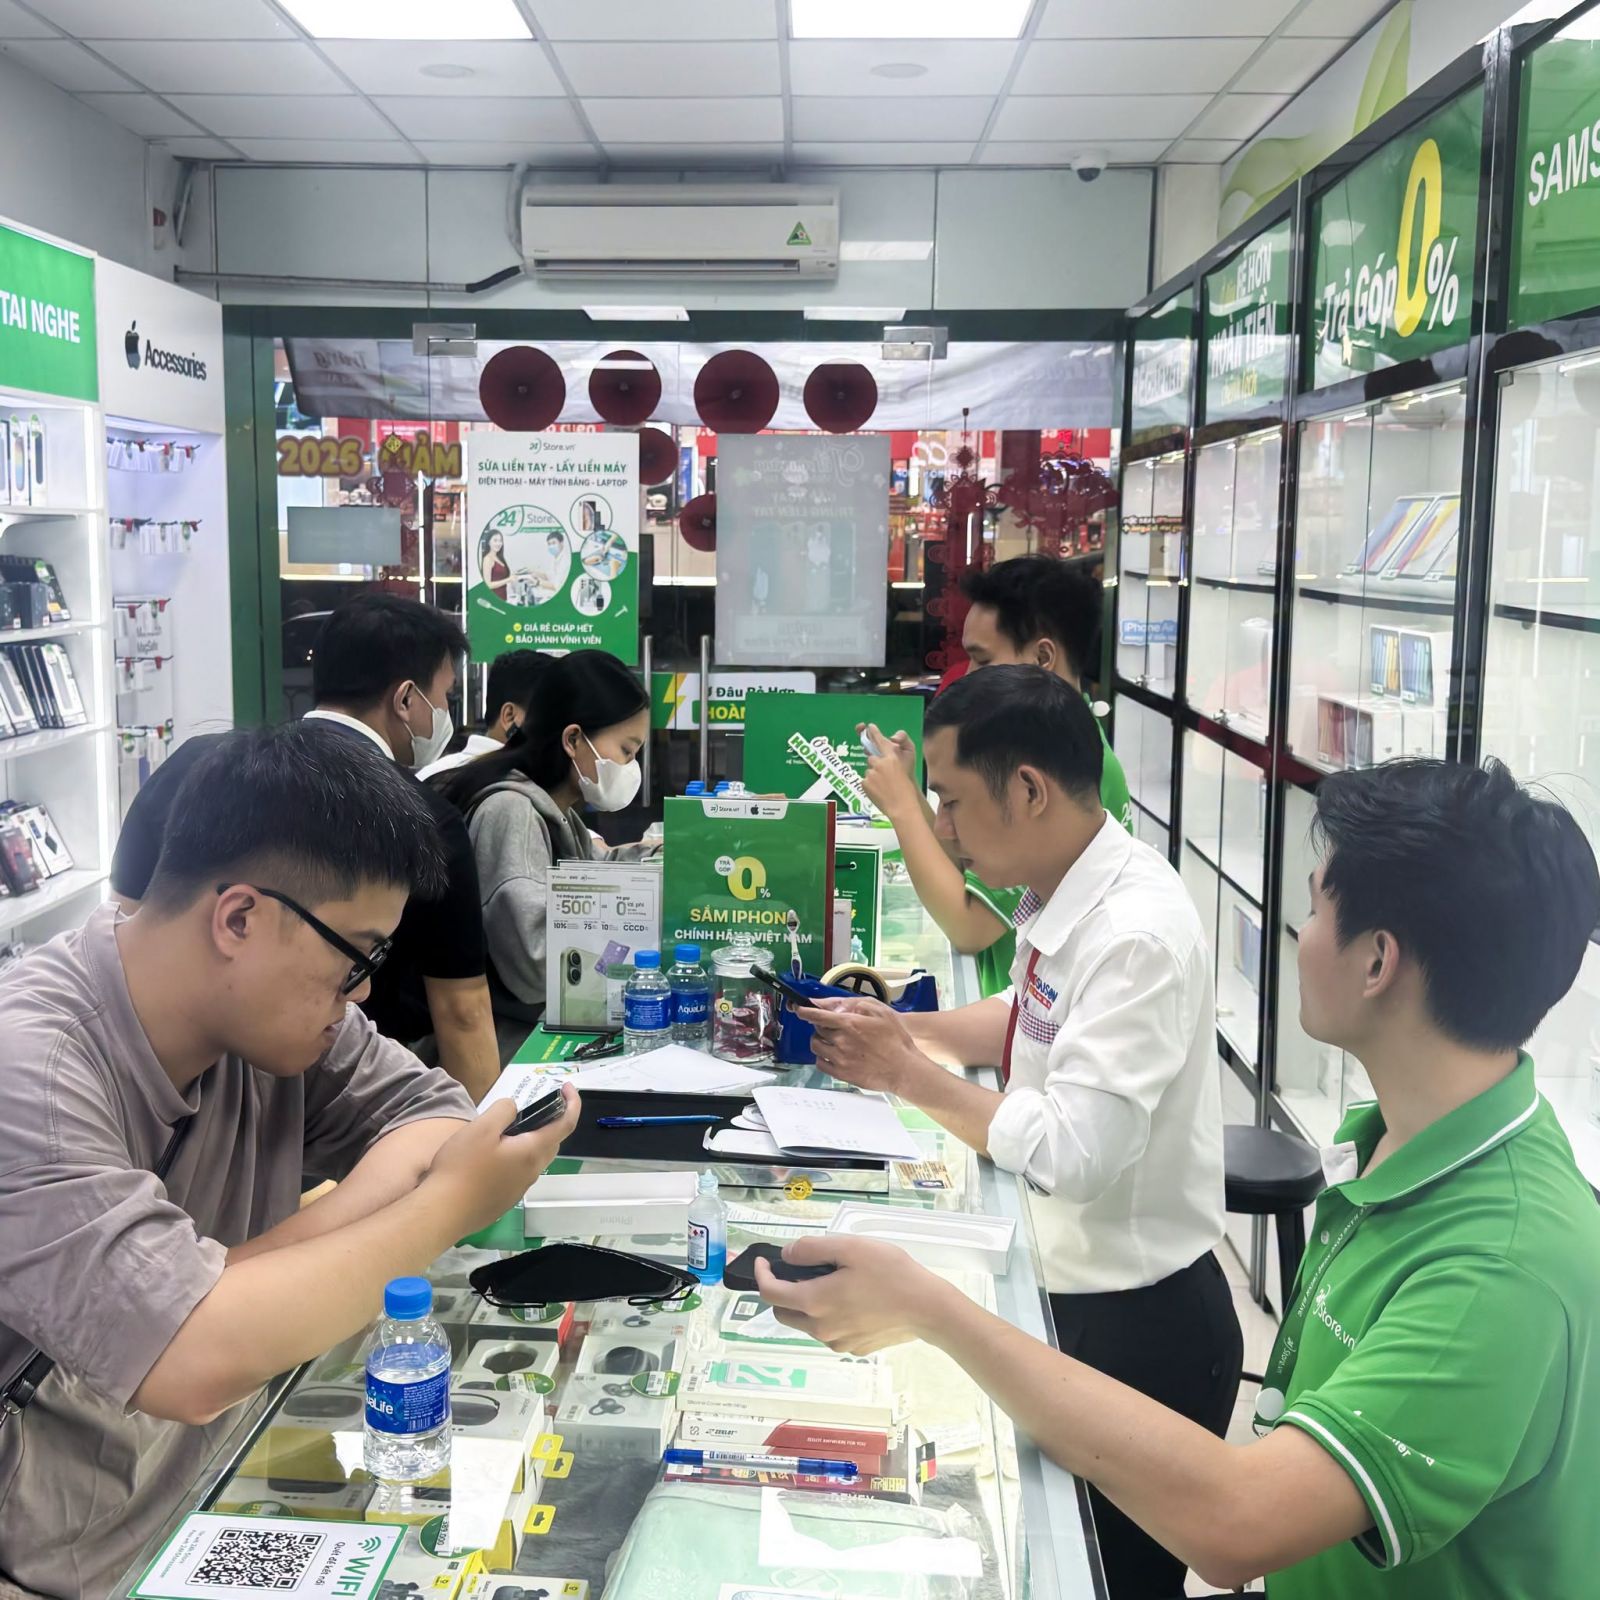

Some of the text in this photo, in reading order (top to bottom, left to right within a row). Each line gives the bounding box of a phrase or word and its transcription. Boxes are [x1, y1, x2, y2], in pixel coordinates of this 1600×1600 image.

[1324, 267, 1350, 341] Trả
[1354, 253, 1398, 339] Góp
[0, 290, 81, 344] TAI NGHE
[144, 339, 207, 381] Accessories
[279, 437, 361, 475] 2026
[478, 459, 499, 472] SỬA
[502, 458, 524, 472] LIỀN
[528, 463, 547, 473] TAY
[556, 458, 575, 472] LẤY
[604, 461, 626, 473] MÁY
[528, 477, 546, 486] MÁY
[548, 477, 567, 486] TÍNH
[596, 479, 628, 487] LAPTOP
[497, 510, 517, 527] 24
[523, 622, 594, 633] GIÁ RẺ CHẤP HẾT
[515, 634, 533, 644] BẢO
[534, 634, 559, 644] HÀNH
[560, 634, 581, 644] VĨNH
[716, 686, 743, 697] Đâu
[791, 736, 826, 772] HOÀN
[732, 909, 788, 925] IPHON
[674, 926, 714, 940] CHÍNH
[754, 929, 781, 944] VIỆT
[332, 1541, 346, 1556] Quét
[331, 1556, 375, 1596] WIFI
